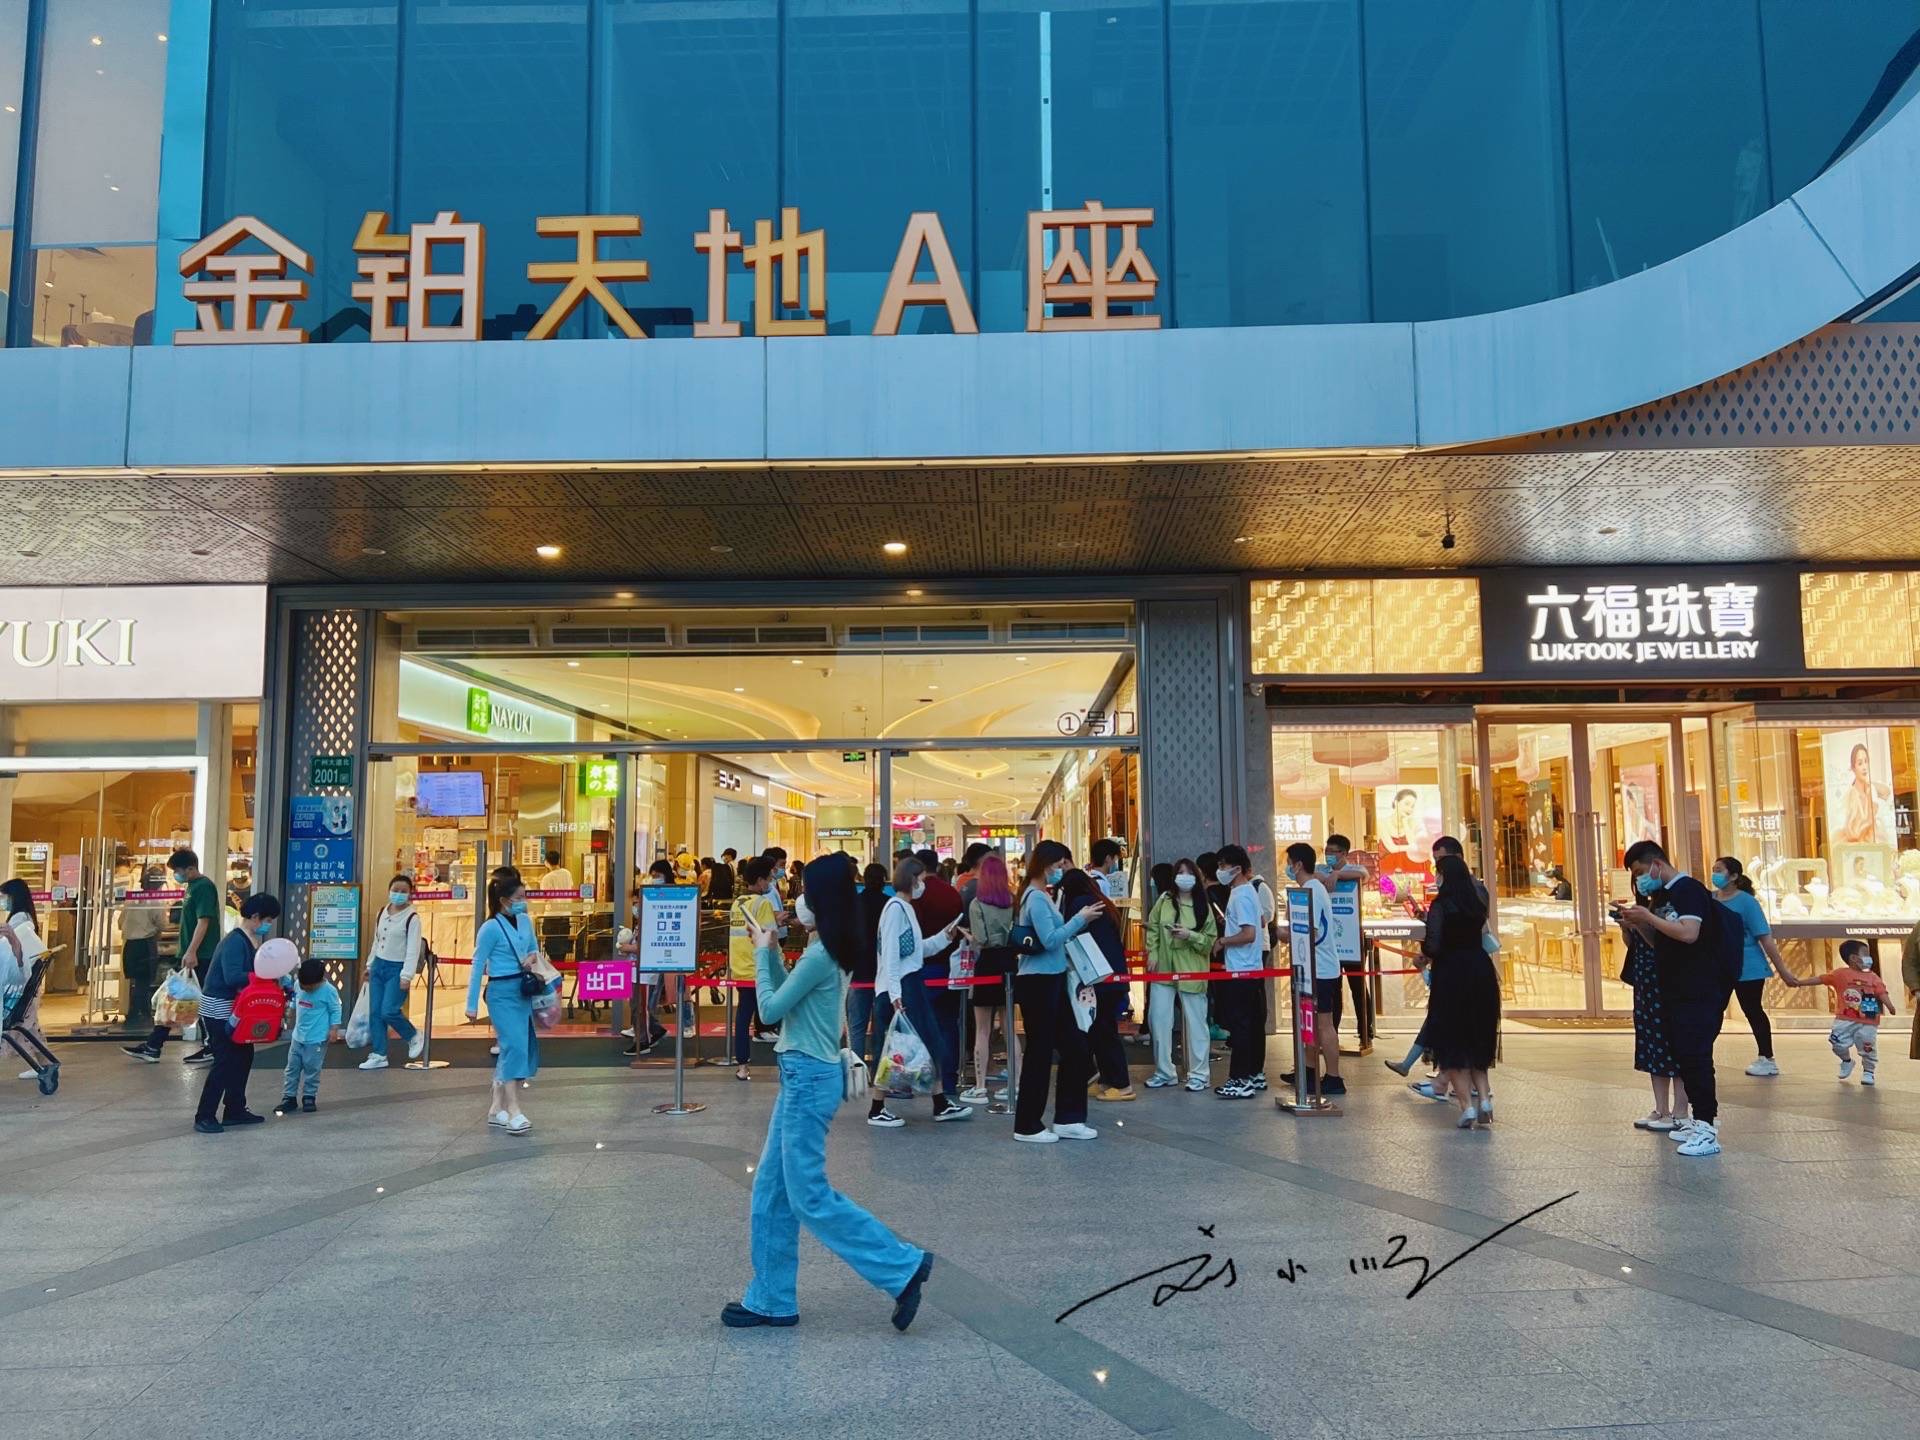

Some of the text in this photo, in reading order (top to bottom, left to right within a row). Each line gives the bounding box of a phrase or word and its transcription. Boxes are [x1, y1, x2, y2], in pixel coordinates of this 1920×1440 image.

[173, 200, 1162, 346] 金铂天地A座
[1527, 583, 1758, 640] 六福珠寶
[1530, 640, 1760, 664] LUKFOOK JEWELLERY
[490, 703, 533, 736] NAYUKI
[314, 768, 338, 783] 2001
[587, 972, 625, 991] 出口
